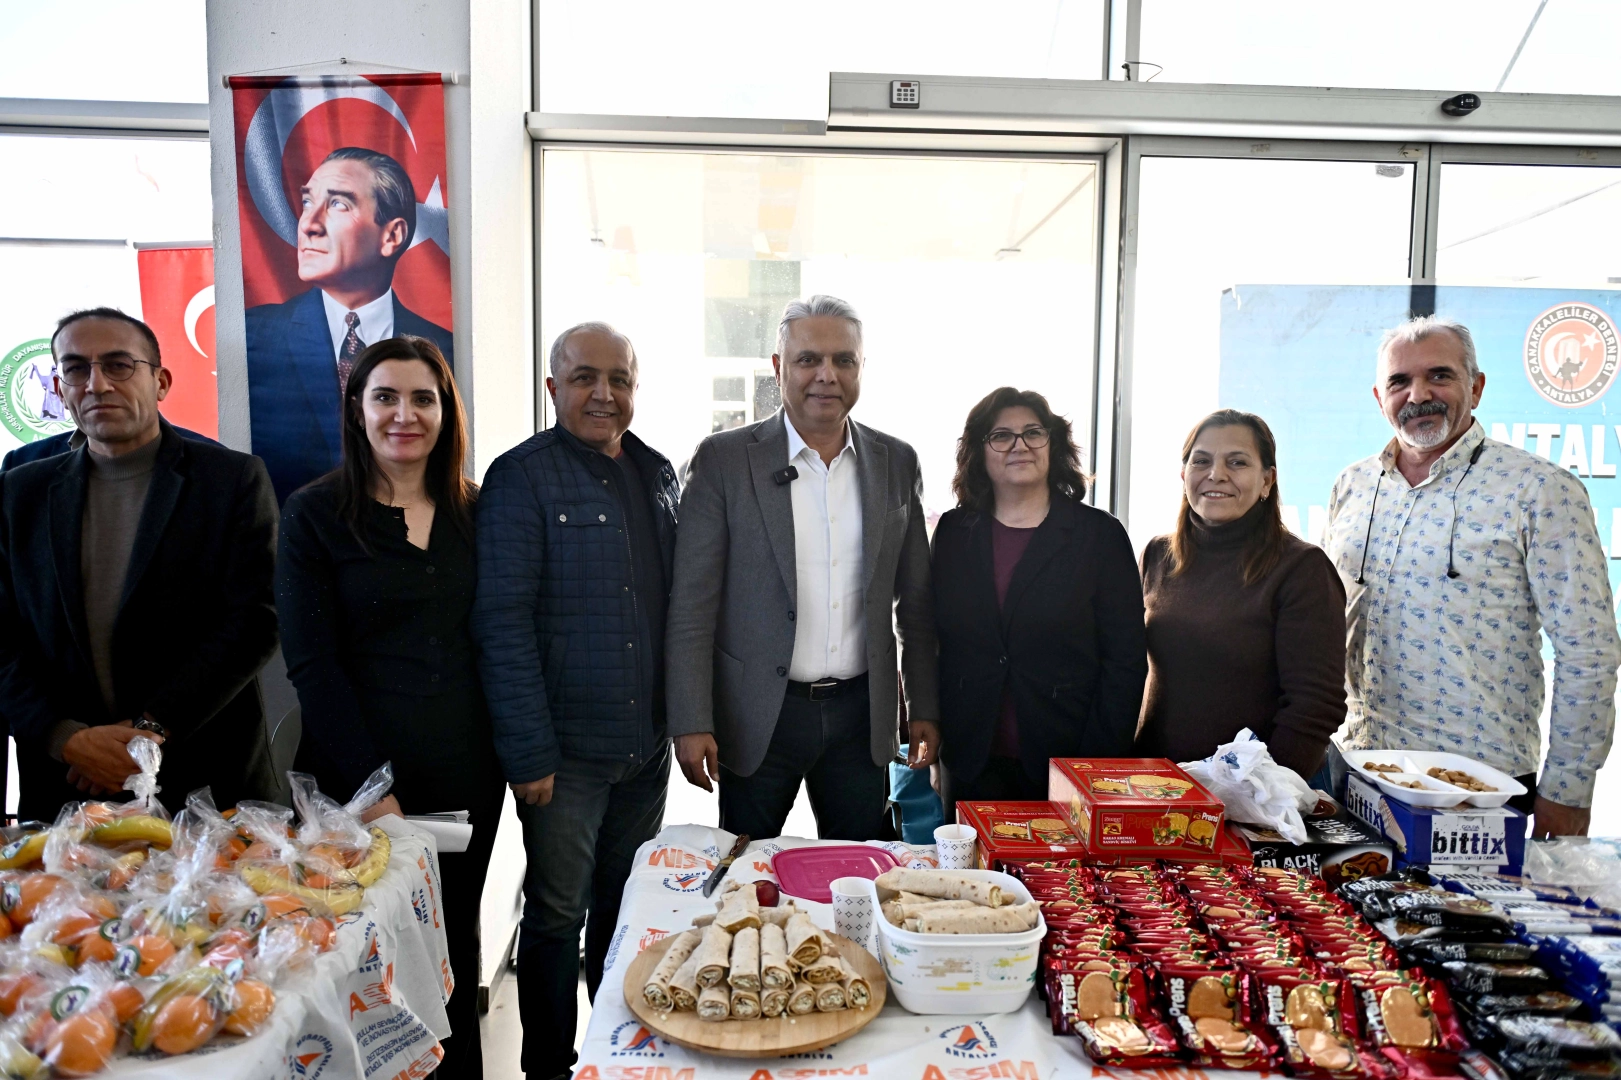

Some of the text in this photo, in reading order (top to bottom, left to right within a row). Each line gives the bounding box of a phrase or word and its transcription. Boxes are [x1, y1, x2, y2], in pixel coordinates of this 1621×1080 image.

[1528, 306, 1599, 374] ÇANAKKALELİLER
[13, 343, 52, 362] DAYANIŞM
[1543, 385, 1595, 402] ANTALYA
[1202, 812, 1219, 822] Prens
[1348, 788, 1381, 829] bittix
[1126, 814, 1172, 829] Prens
[1432, 831, 1505, 855] bittix
[1260, 853, 1318, 869] BLACK
[1061, 973, 1077, 1014] Prens
[1169, 977, 1186, 1017] Prens
[1268, 985, 1285, 1026] Prens
